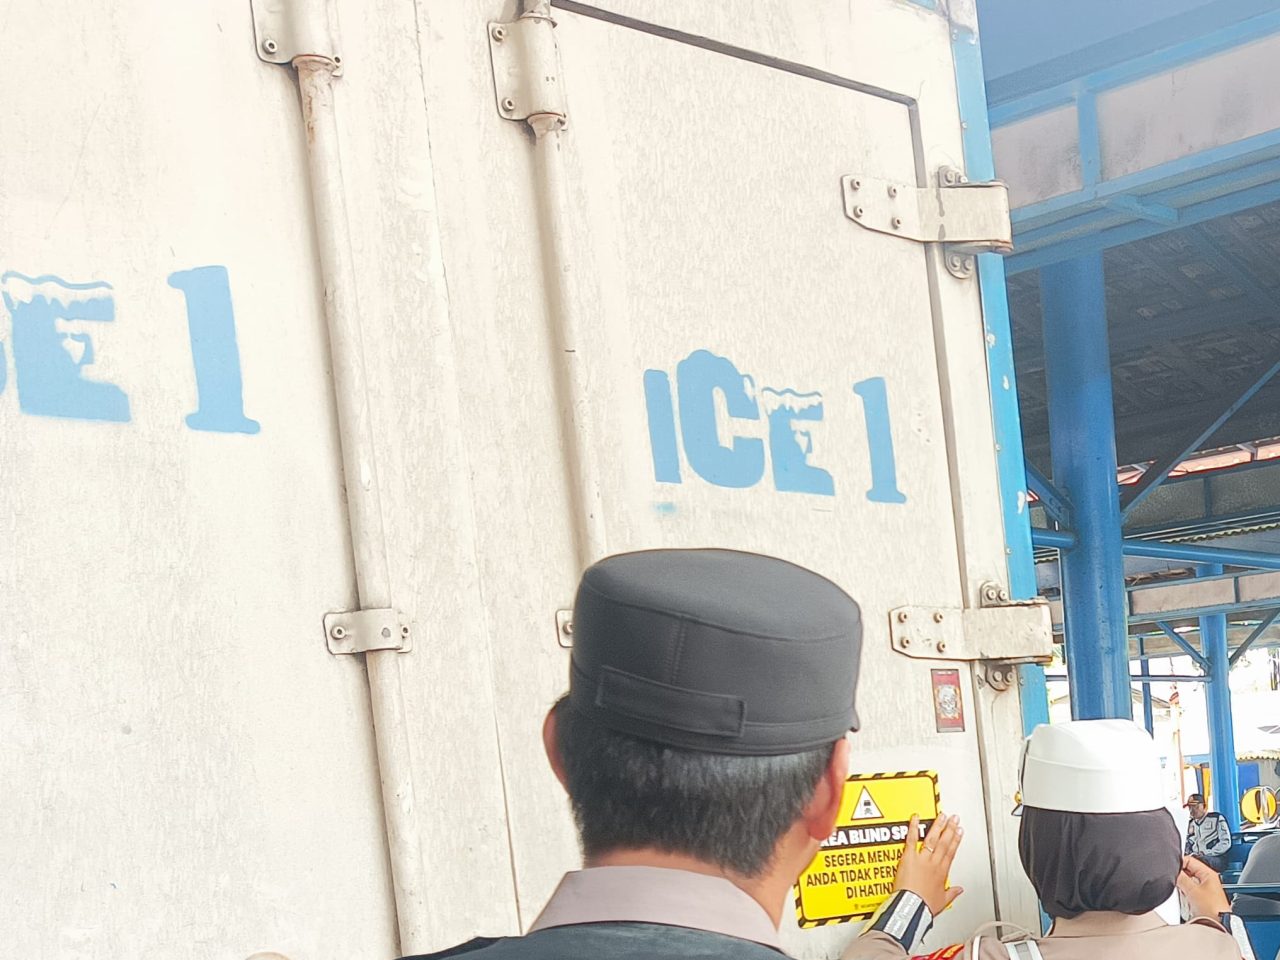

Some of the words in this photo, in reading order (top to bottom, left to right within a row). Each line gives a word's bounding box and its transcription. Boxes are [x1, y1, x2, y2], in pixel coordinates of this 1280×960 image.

[0, 270, 131, 422] E
[167, 265, 261, 434] 1
[643, 349, 835, 496] ICE
[853, 376, 907, 504] 1
[849, 827, 890, 843] BLIND
[892, 824, 926, 840] SPT
[824, 851, 866, 868] SEGERA
[867, 847, 903, 863] MENJA
[806, 873, 838, 887] ANDA
[839, 868, 872, 883] TIDAK
[873, 865, 898, 879] PERN
[846, 885, 858, 899] DI
[860, 881, 894, 897] HATIN
